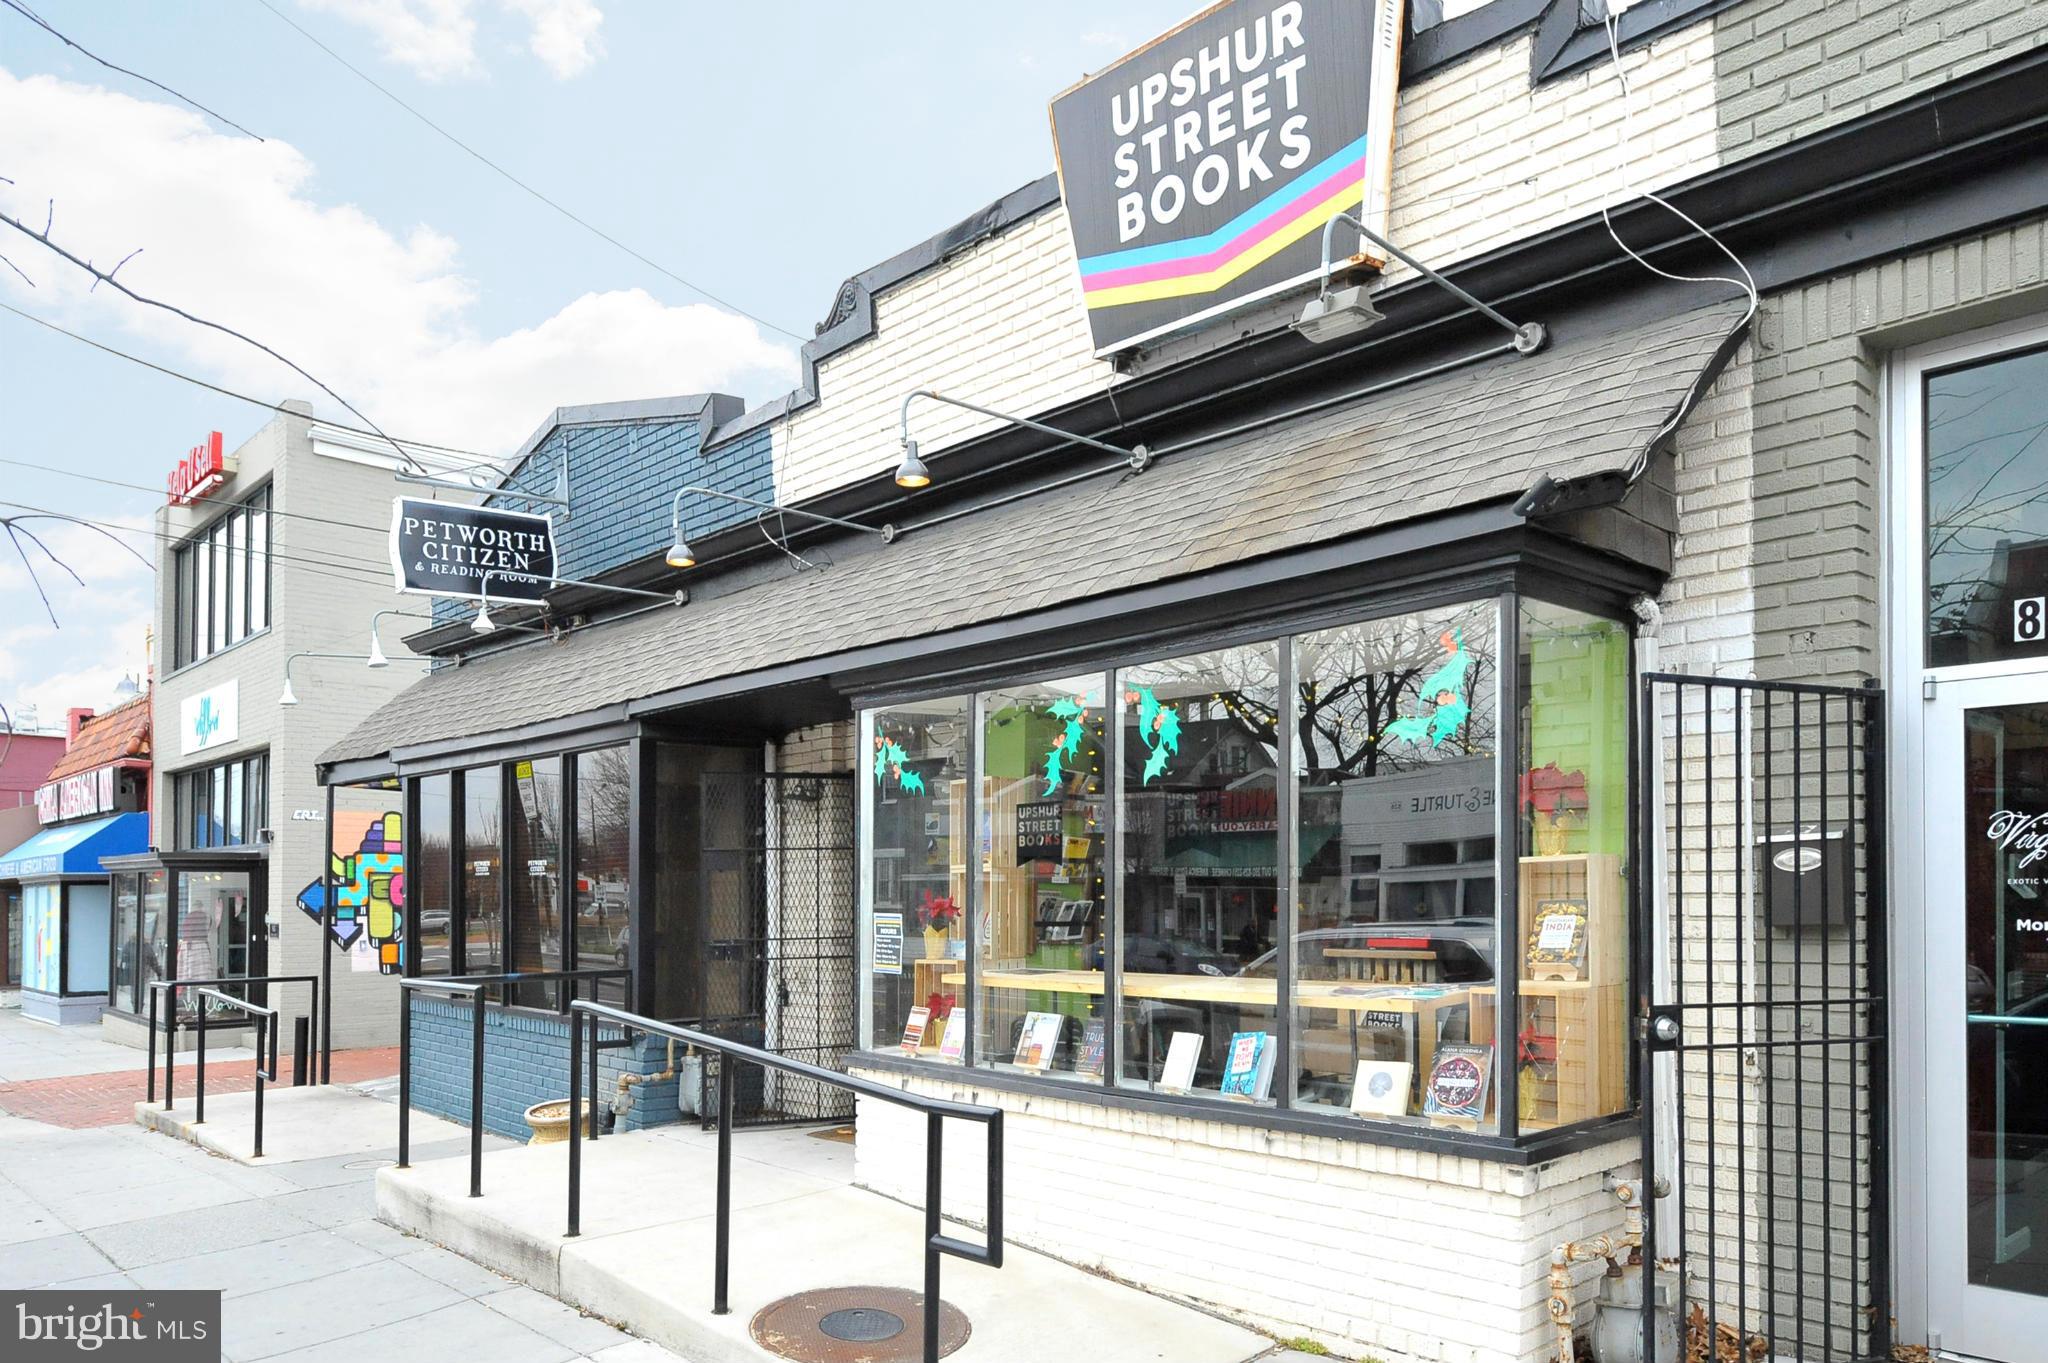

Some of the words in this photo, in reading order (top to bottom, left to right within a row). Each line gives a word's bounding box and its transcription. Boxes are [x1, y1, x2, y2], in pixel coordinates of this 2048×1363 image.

[1111, 1, 1305, 136] UPSHUR
[1114, 54, 1307, 189] STREET
[1117, 115, 1311, 243] BOOKS
[404, 517, 546, 552] PETWORTH
[422, 542, 529, 570] CITIZEN
[415, 561, 425, 571] &
[431, 562, 493, 579] READING
[2018, 600, 2041, 640] 8
[1018, 804, 1061, 819] UPSHUR
[1018, 819, 1061, 833] STREET
[1018, 833, 1061, 848] BOOKS
[1545, 923, 1572, 931] INDIA
[1368, 1012, 1401, 1022] STREET
[1080, 1046, 1104, 1057] STYLE
